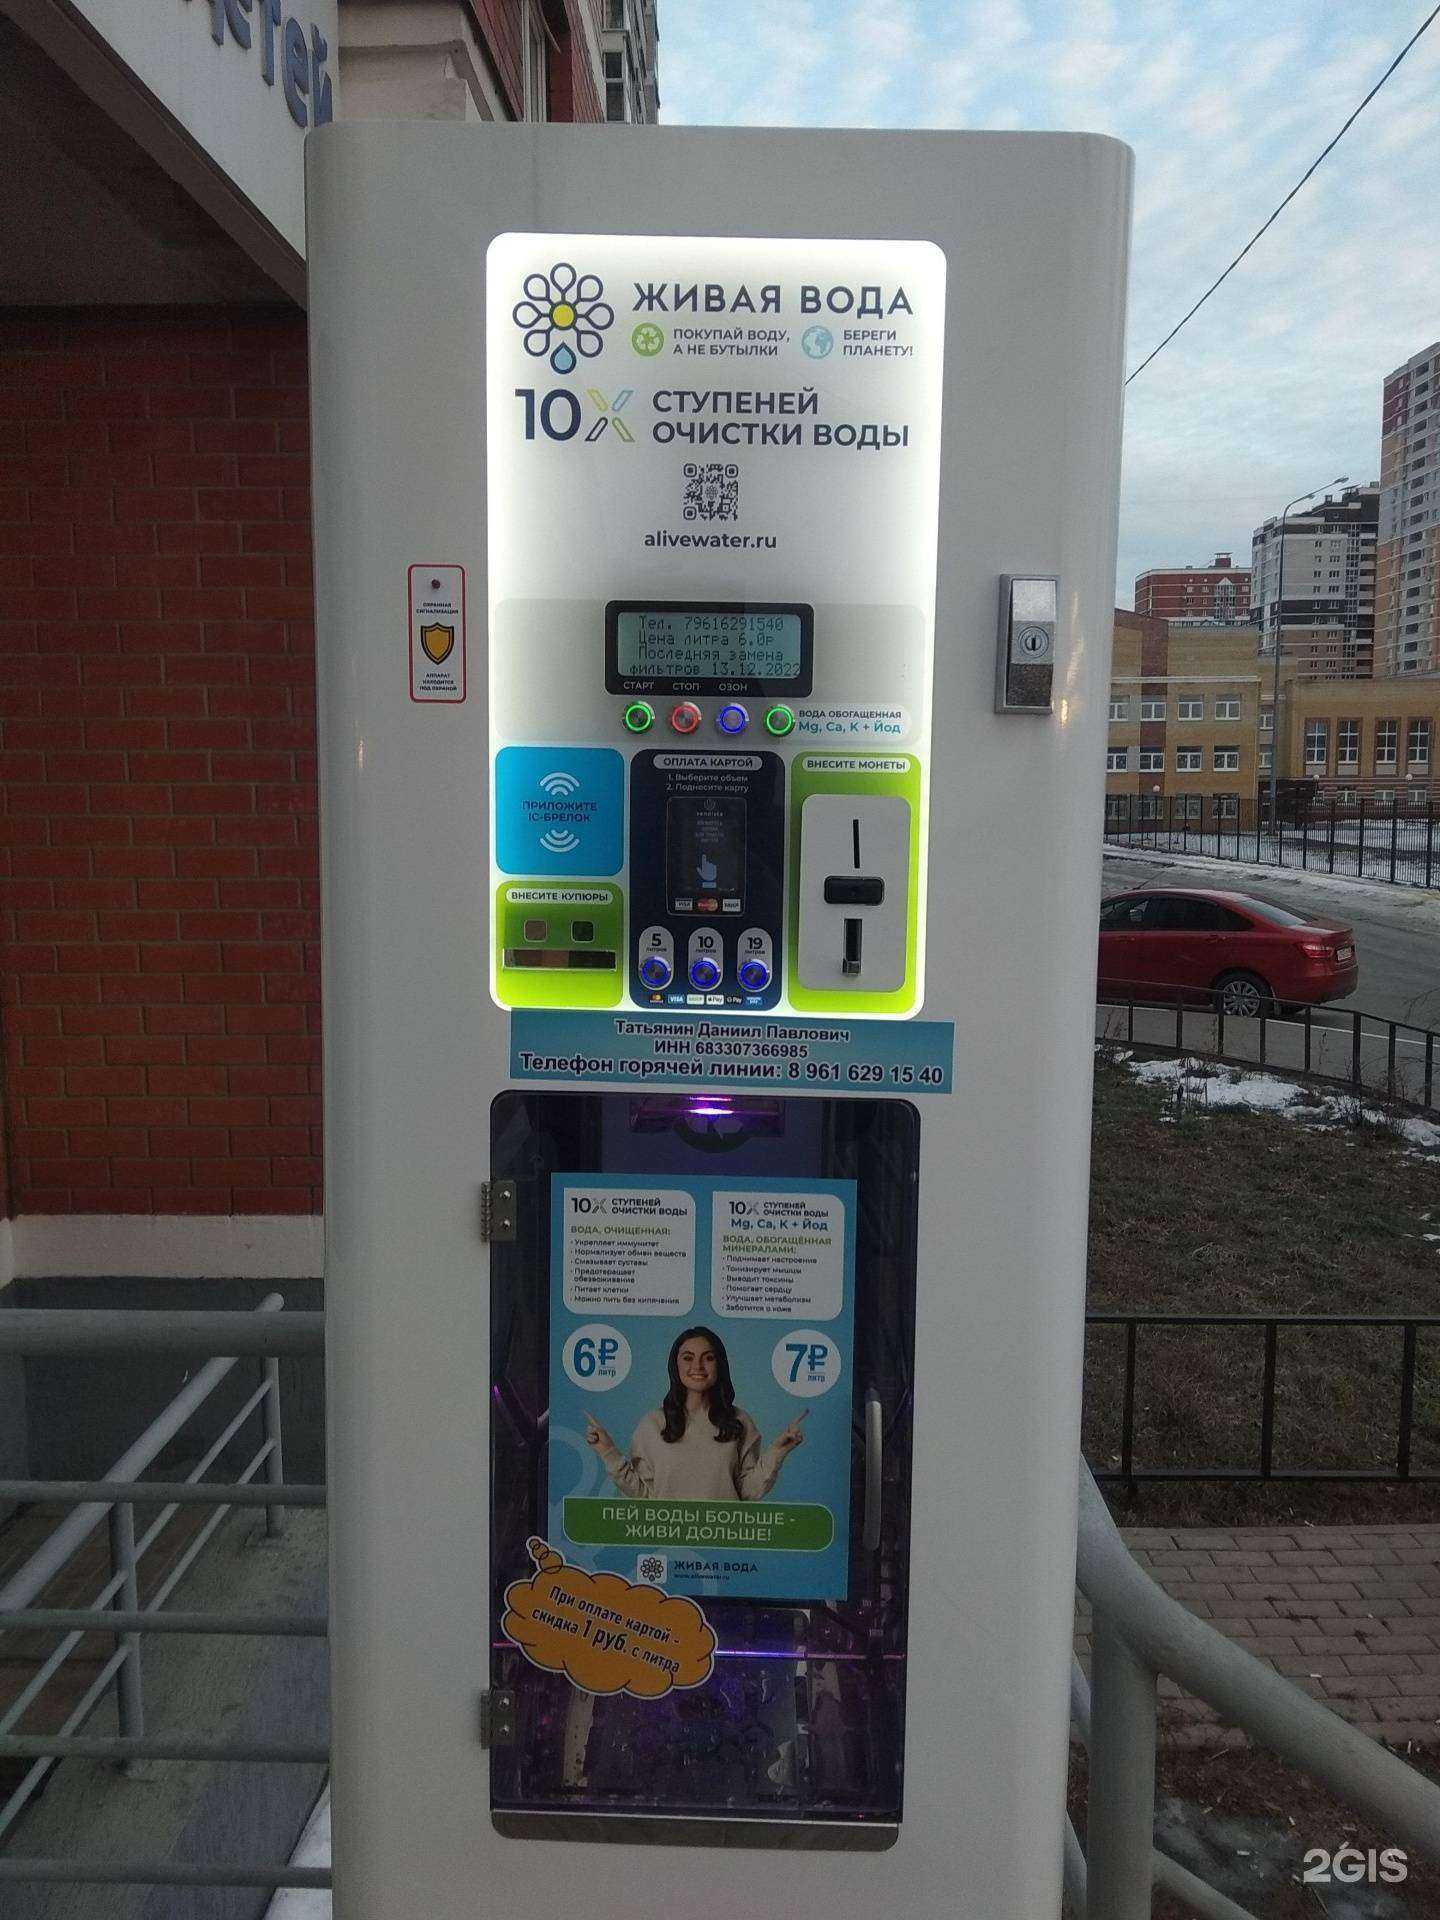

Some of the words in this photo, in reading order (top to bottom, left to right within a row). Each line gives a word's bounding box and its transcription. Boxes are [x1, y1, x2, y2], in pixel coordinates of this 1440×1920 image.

[632, 283, 782, 313] ЖИВАЯ
[800, 285, 914, 319] ВОДА
[673, 327, 744, 342] ПОКУПАЙ
[747, 329, 790, 343] ВОДУ,
[843, 329, 897, 342] БЕРЕГИ
[672, 343, 684, 356] А
[687, 344, 706, 356] НЕ
[709, 344, 778, 357] БУТЫЛКИ
[843, 344, 914, 358] ПЛАНЕТУ!
[652, 387, 819, 415] СТУПЕНЕЙ
[652, 421, 802, 446] ОЧИСТКИ
[813, 424, 909, 451] ВОДЫ
[644, 531, 777, 550] alivewater.ru
[638, 615, 672, 628] Тел.
[684, 616, 784, 632] 79616291540
[638, 629, 675, 646] Цена
[684, 636, 729, 646] литра
[638, 645, 720, 662] Последняя
[729, 651, 784, 662] замена
[629, 664, 700, 676] фильтров
[623, 681, 655, 690] СТАРТ
[672, 683, 700, 691] СТОП
[718, 683, 748, 692] ОЗОН
[800, 710, 827, 719] ВОДА
[829, 711, 902, 720] ОБОГАЩЕННАЯ
[799, 722, 822, 734] Mg,
[826, 722, 846, 734] Ca,
[874, 720, 902, 734] Йод
[664, 757, 707, 768] ОПЛАТА
[710, 757, 753, 768] КАРТОЙ
[807, 760, 856, 770] ВНЕСИТЕ
[858, 760, 906, 770] МОНЕТЫ
[676, 774, 718, 782] Выберите
[724, 785, 749, 793] карту
[522, 800, 597, 811] ПРИЛОЖИТЕ
[512, 891, 558, 900] ВНЕСИТЕ
[562, 892, 608, 901] КУПЮРЫ
[652, 933, 661, 946] 5
[698, 936, 714, 949] 10
[747, 937, 763, 949] 19
[615, 1020, 694, 1036] Татьянин
[698, 1023, 762, 1039] Даниил
[766, 1026, 850, 1042] Павлович
[654, 1040, 690, 1055] ИНН
[696, 1042, 808, 1059] 683307366985
[520, 1053, 614, 1075] Телефон
[619, 1060, 703, 1077] горячей
[709, 1062, 781, 1079] линии:
[788, 1063, 800, 1079] 8
[806, 1064, 840, 1081] 961
[847, 1065, 883, 1082] 629
[890, 1067, 913, 1083] 15
[918, 1068, 943, 1084] 40
[611, 1198, 661, 1207] СТУПЕНЕЙ
[611, 1207, 656, 1215] ОЧИСТКИ
[659, 1208, 688, 1217] ВОДЫ
[804, 1210, 829, 1218] ВОДЫ
[604, 1226, 671, 1236] ОЧИЩЕННАЯ:
[731, 1219, 754, 1231] Mg,
[757, 1219, 776, 1230] Ca,
[802, 1218, 828, 1231] Йод
[575, 1249, 625, 1258] Нормализует
[722, 1244, 797, 1254] МИНЕРАЛАМИ:
[726, 1285, 762, 1293] Помогает
[598, 1368, 616, 1378] литр
[807, 1374, 826, 1383] литр
[602, 1505, 640, 1521] ПЕЙ
[645, 1508, 699, 1525] ВОДЫ
[705, 1510, 784, 1525] БОЛЬШЕ
[625, 1524, 681, 1539] ЖИВИ
[685, 1526, 771, 1542] ДОЛЬШЕ!
[674, 1561, 719, 1571] ЖИВАЯ
[723, 1562, 758, 1574] ВОДА
[549, 1585, 576, 1608] При
[578, 1599, 623, 1624] оплате
[625, 1617, 671, 1643] картой
[531, 1607, 579, 1635] скидка
[583, 1619, 593, 1638] 1
[592, 1629, 627, 1654] руб.
[631, 1647, 639, 1658] с
[641, 1652, 681, 1673] литра
